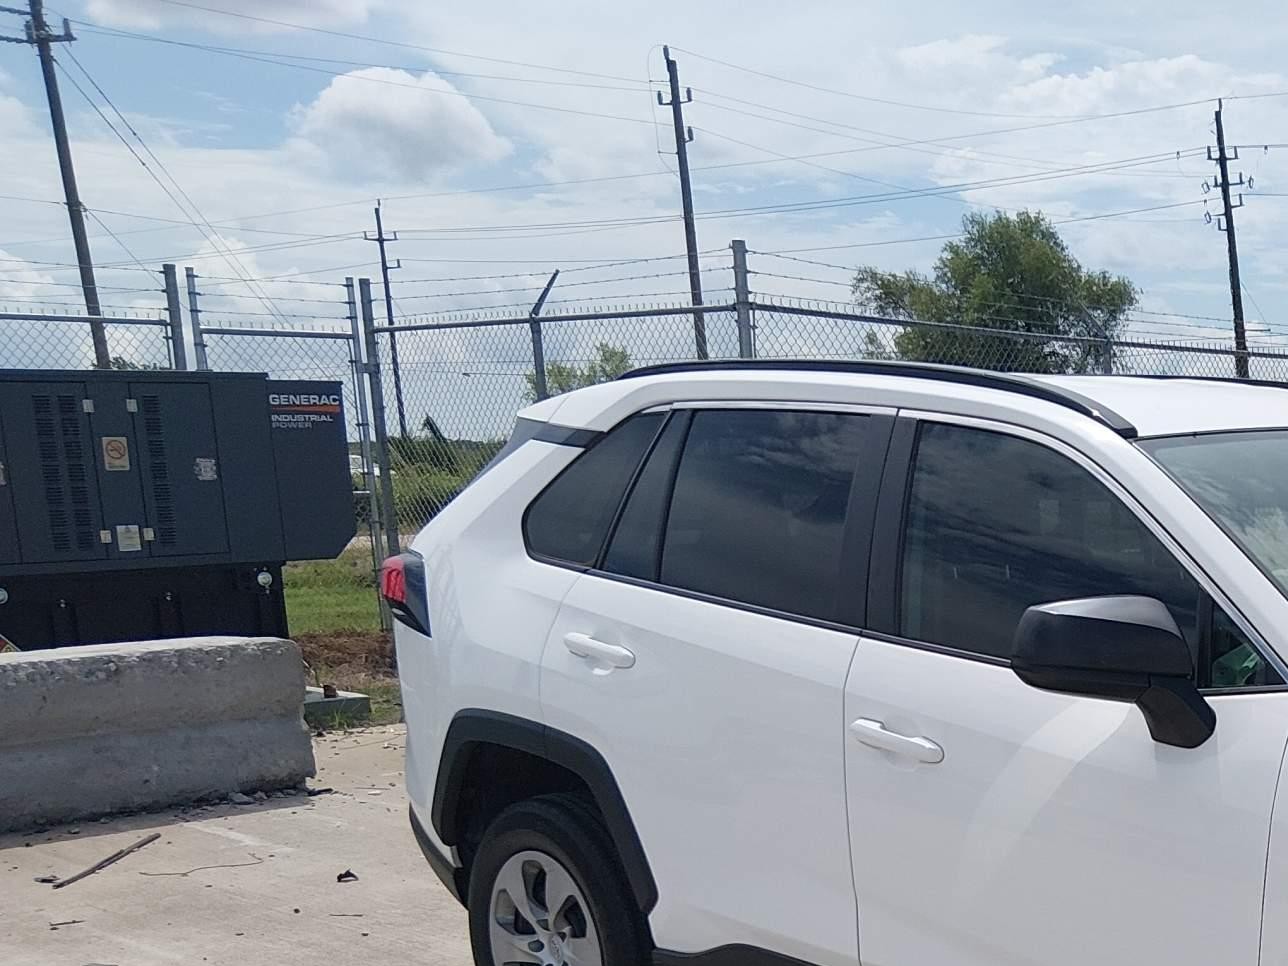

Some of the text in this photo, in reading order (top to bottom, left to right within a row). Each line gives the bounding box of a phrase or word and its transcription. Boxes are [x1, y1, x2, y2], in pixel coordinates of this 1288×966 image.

[269, 394, 340, 405] GENERAC
[271, 414, 334, 422] INDUSTRIAL
[271, 421, 313, 429] POWER
